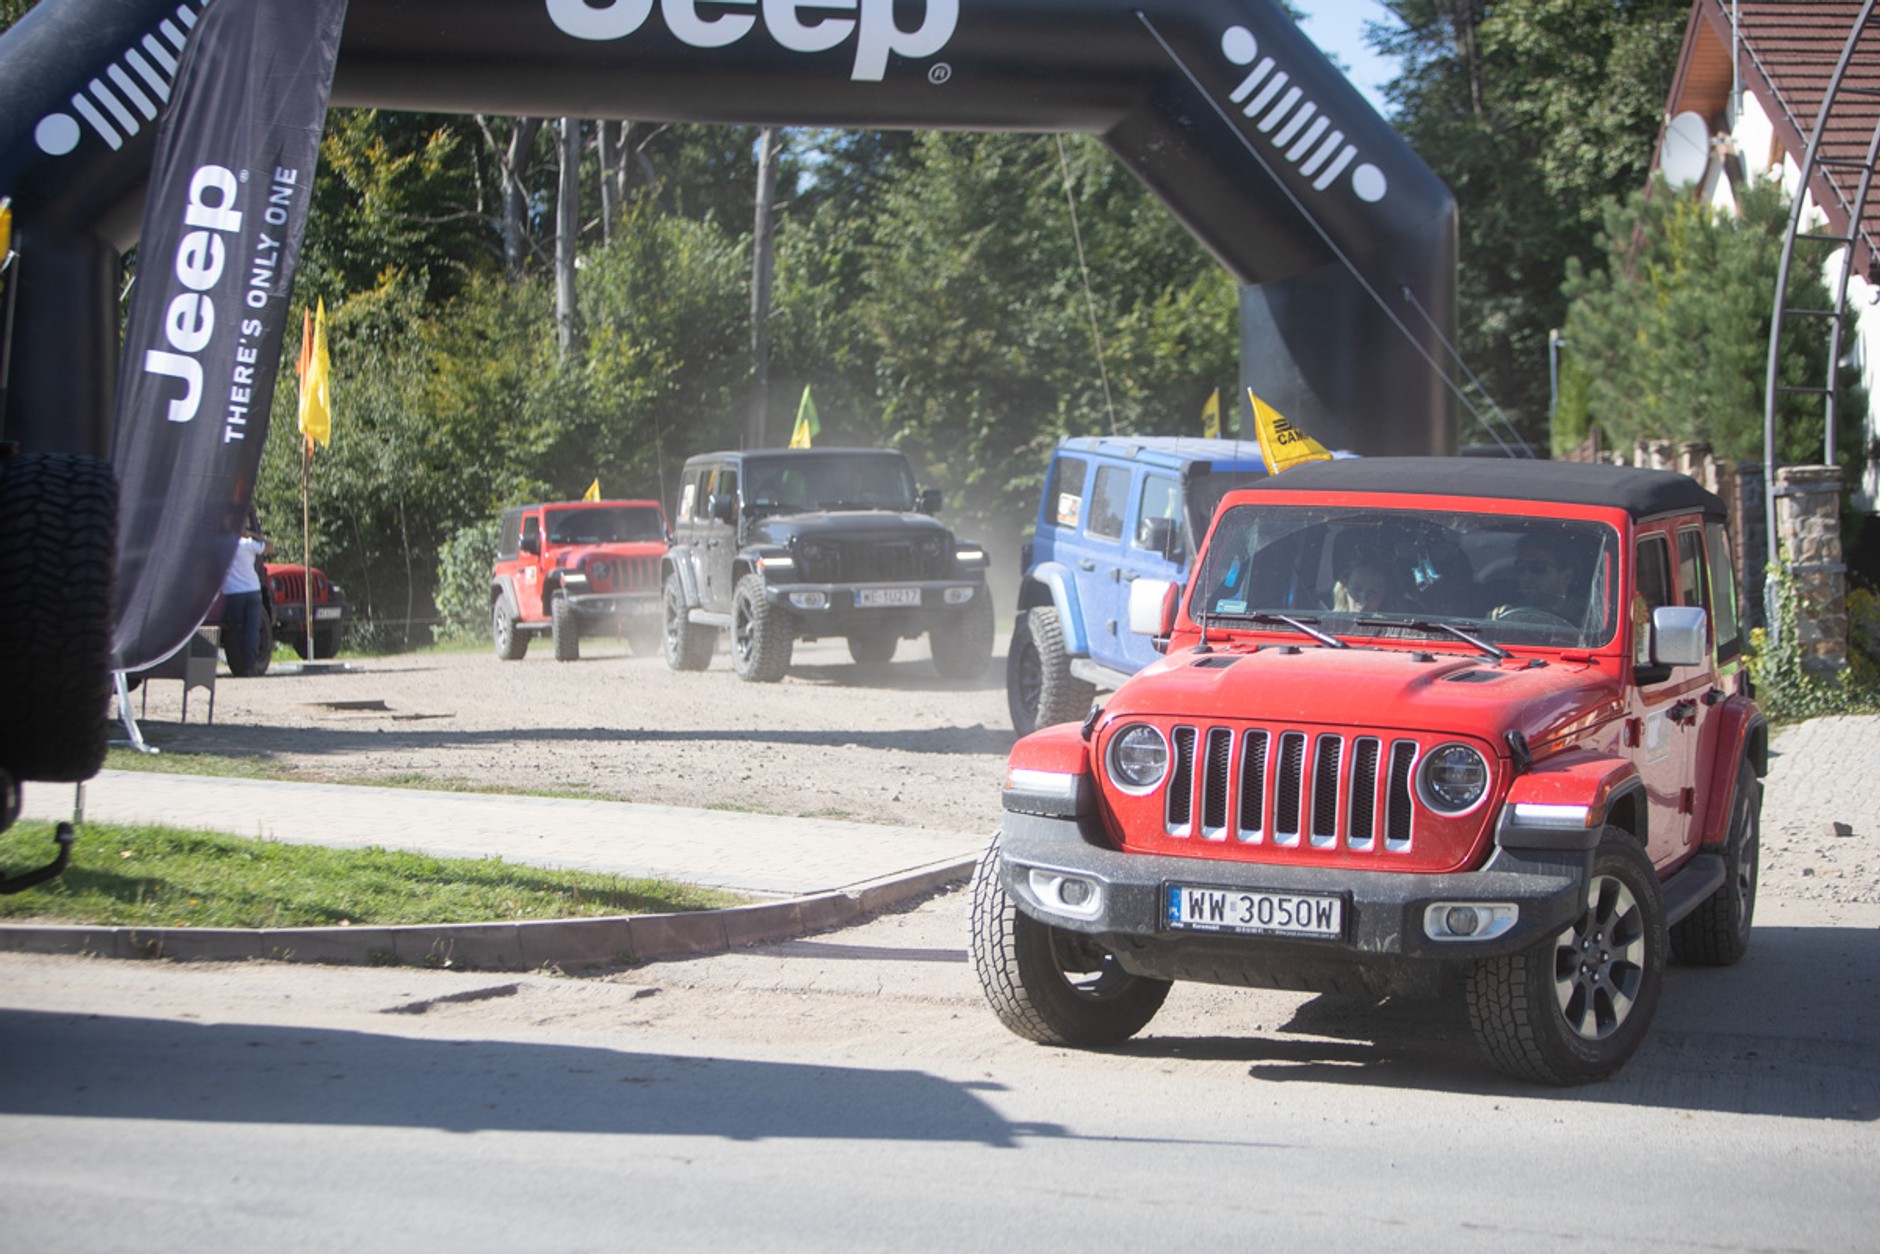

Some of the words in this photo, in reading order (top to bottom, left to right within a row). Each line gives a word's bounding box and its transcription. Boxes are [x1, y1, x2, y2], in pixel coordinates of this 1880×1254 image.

[144, 164, 243, 422] Jeep
[224, 318, 262, 444] THERE'S
[247, 232, 280, 309] ONLY
[264, 166, 298, 226] ONE
[1189, 890, 1226, 922] WW
[1239, 895, 1333, 930] 3050W
